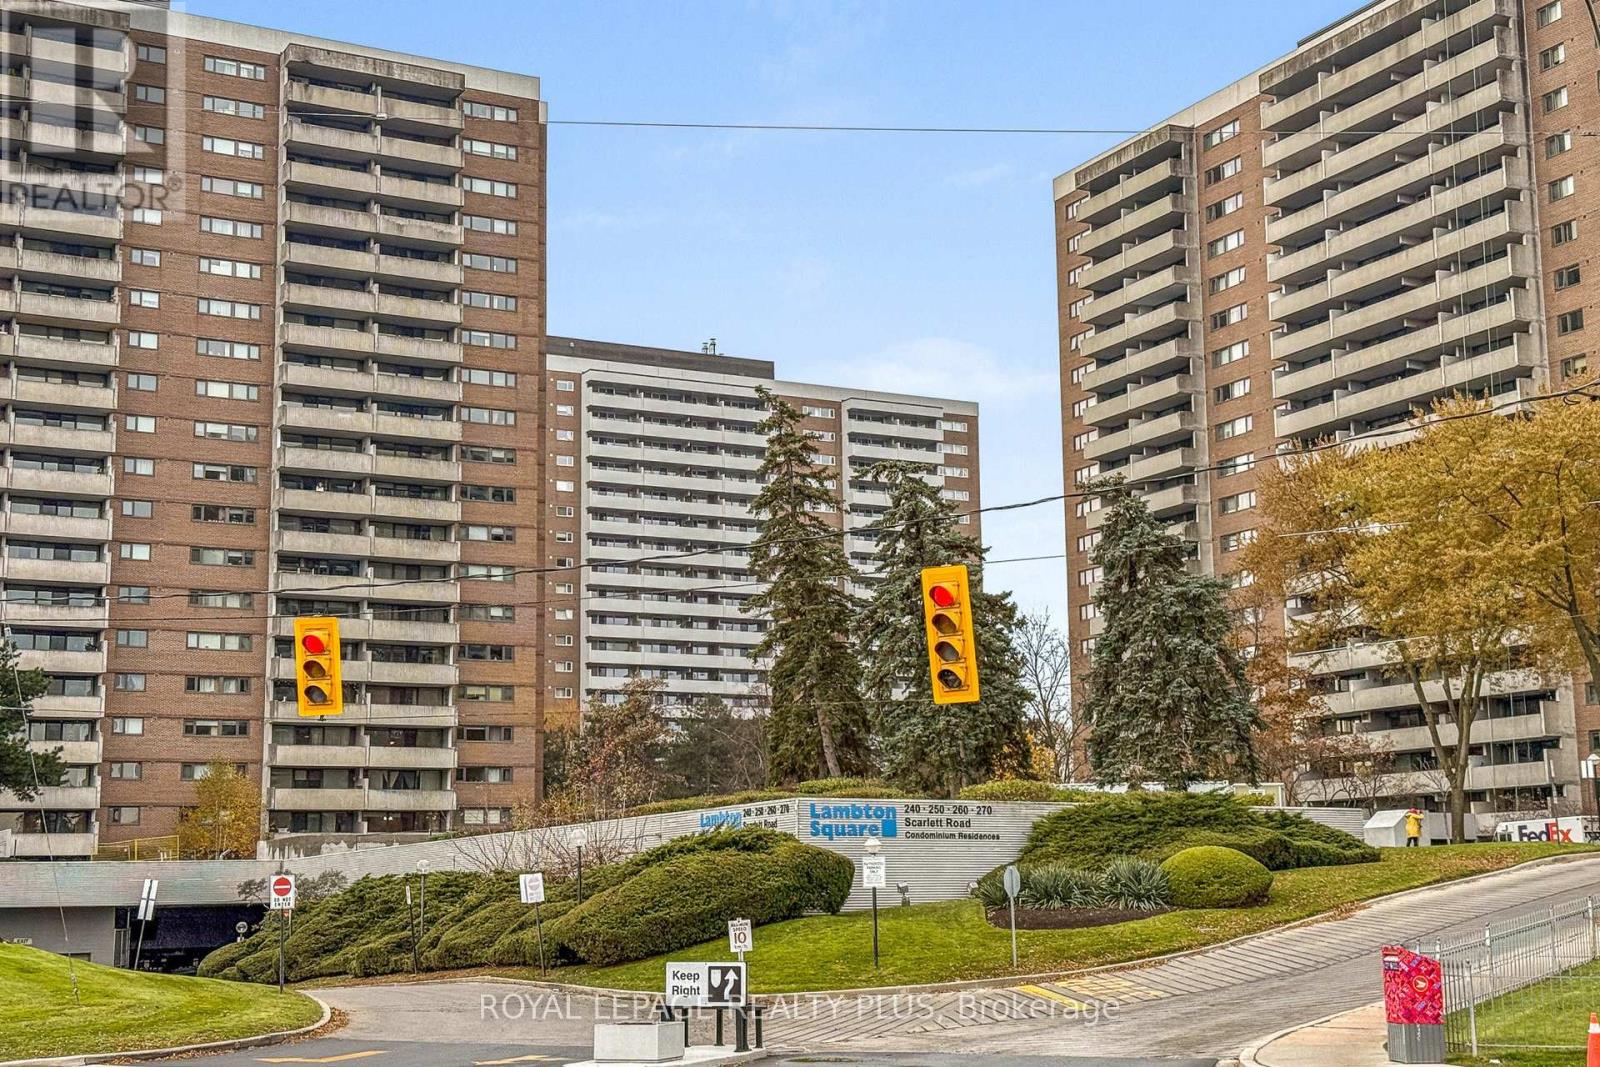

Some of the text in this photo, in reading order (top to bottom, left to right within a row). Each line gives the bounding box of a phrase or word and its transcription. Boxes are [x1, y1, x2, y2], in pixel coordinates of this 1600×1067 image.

[810, 803, 896, 819] Lambton
[904, 804, 993, 815] 240 250 260 270
[904, 818, 972, 828] Scarlett Road
[810, 820, 880, 841] Square
[905, 831, 1000, 841] Condominium Residences
[1518, 822, 1573, 843] FedEx
[734, 932, 746, 944] 10
[672, 970, 700, 983] Keep
[672, 985, 700, 998] Right
